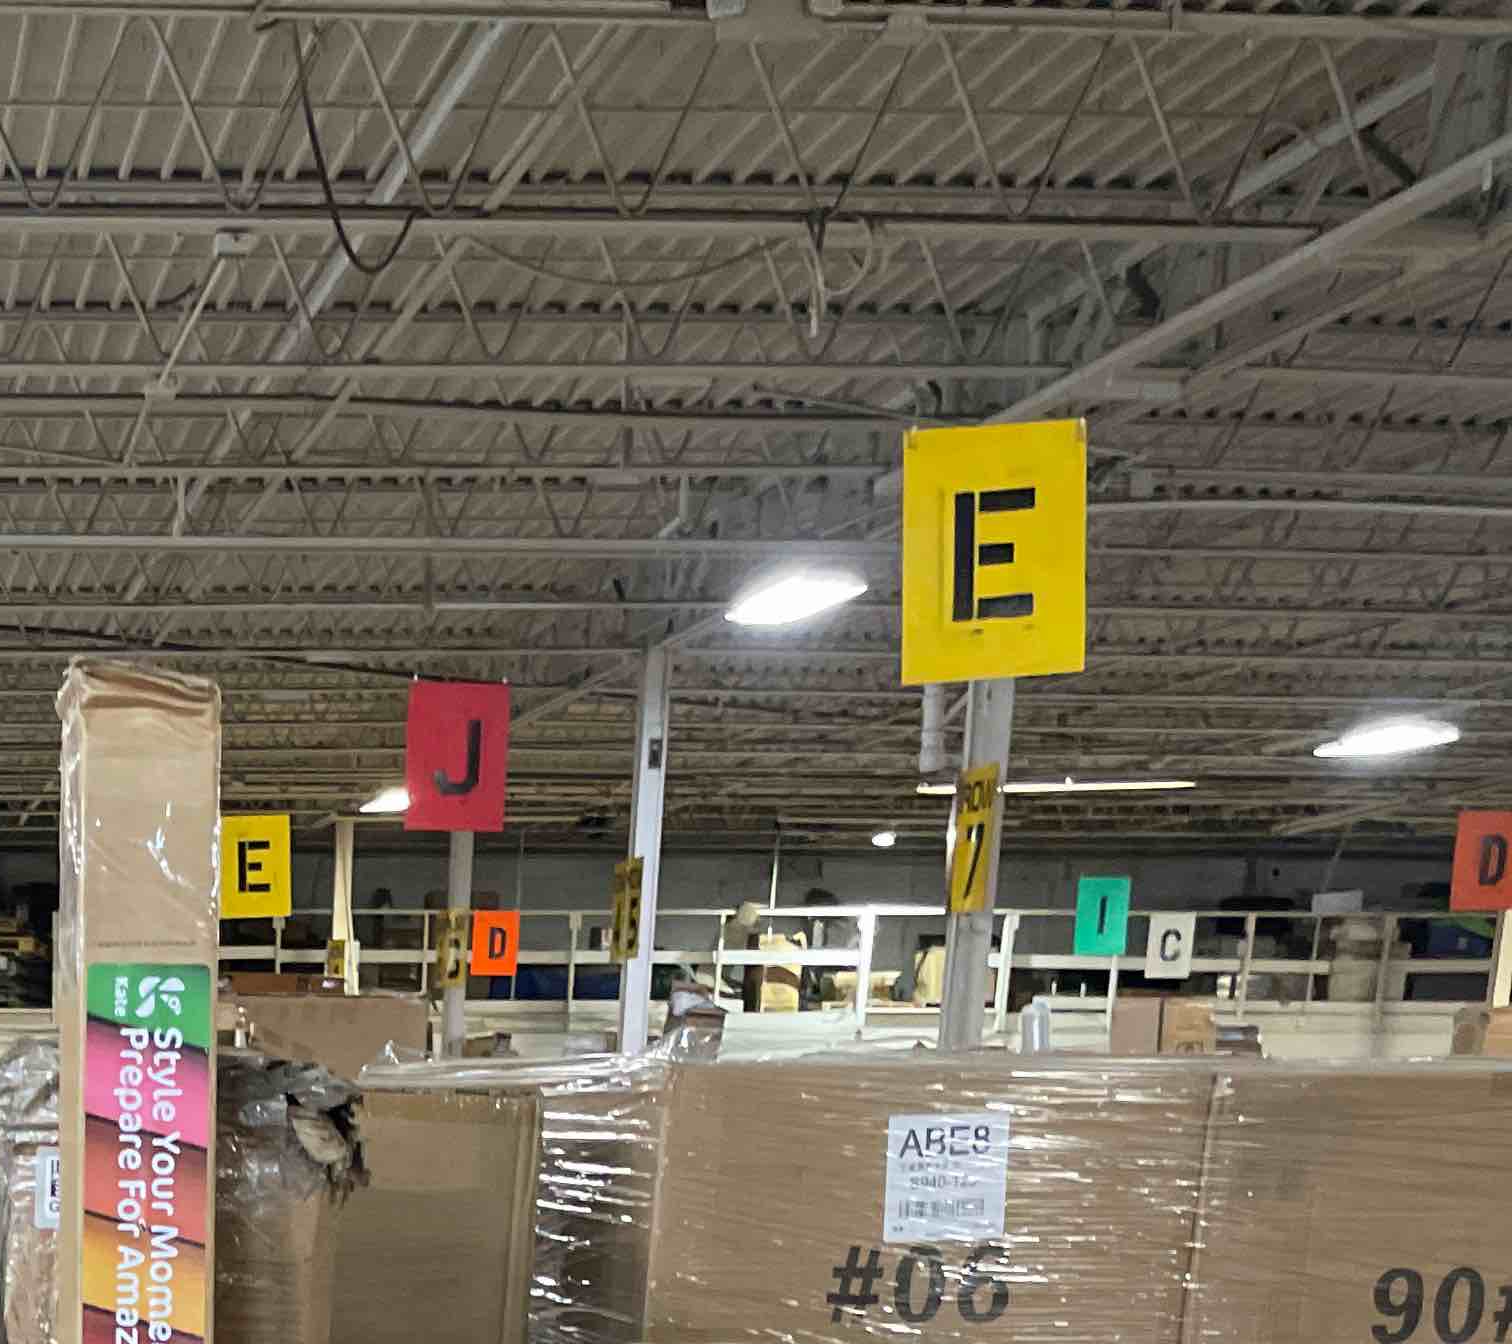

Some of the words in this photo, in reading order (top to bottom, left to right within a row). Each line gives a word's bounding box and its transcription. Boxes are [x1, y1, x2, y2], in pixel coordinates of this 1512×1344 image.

[952, 487, 1036, 622] E
[432, 719, 482, 795] J
[238, 839, 270, 893] E
[1479, 834, 1507, 886] D
[489, 926, 506, 960] D
[1160, 928, 1181, 961] C
[114, 976, 129, 1017] Kate
[114, 1027, 149, 1169] Prepare
[147, 1027, 184, 1122] Style
[899, 1125, 992, 1160] ABE8
[146, 1128, 182, 1217] Your
[115, 1174, 146, 1238] For
